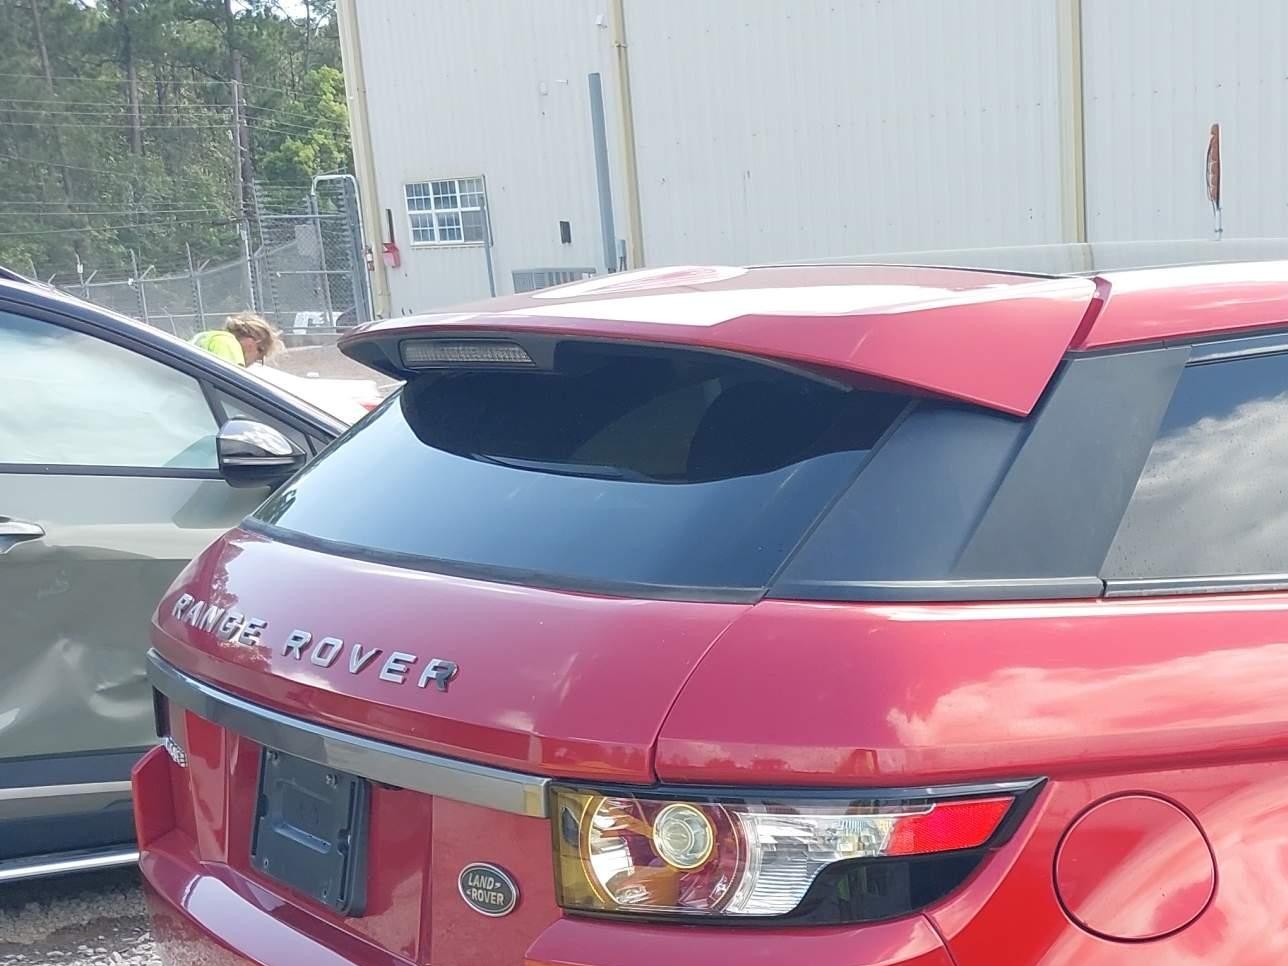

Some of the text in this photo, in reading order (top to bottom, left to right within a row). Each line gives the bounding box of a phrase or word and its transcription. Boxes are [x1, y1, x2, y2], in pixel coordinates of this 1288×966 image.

[171, 593, 459, 692] RANGE ROVER
[468, 872, 495, 890] LAND
[471, 888, 505, 906] ROVER
